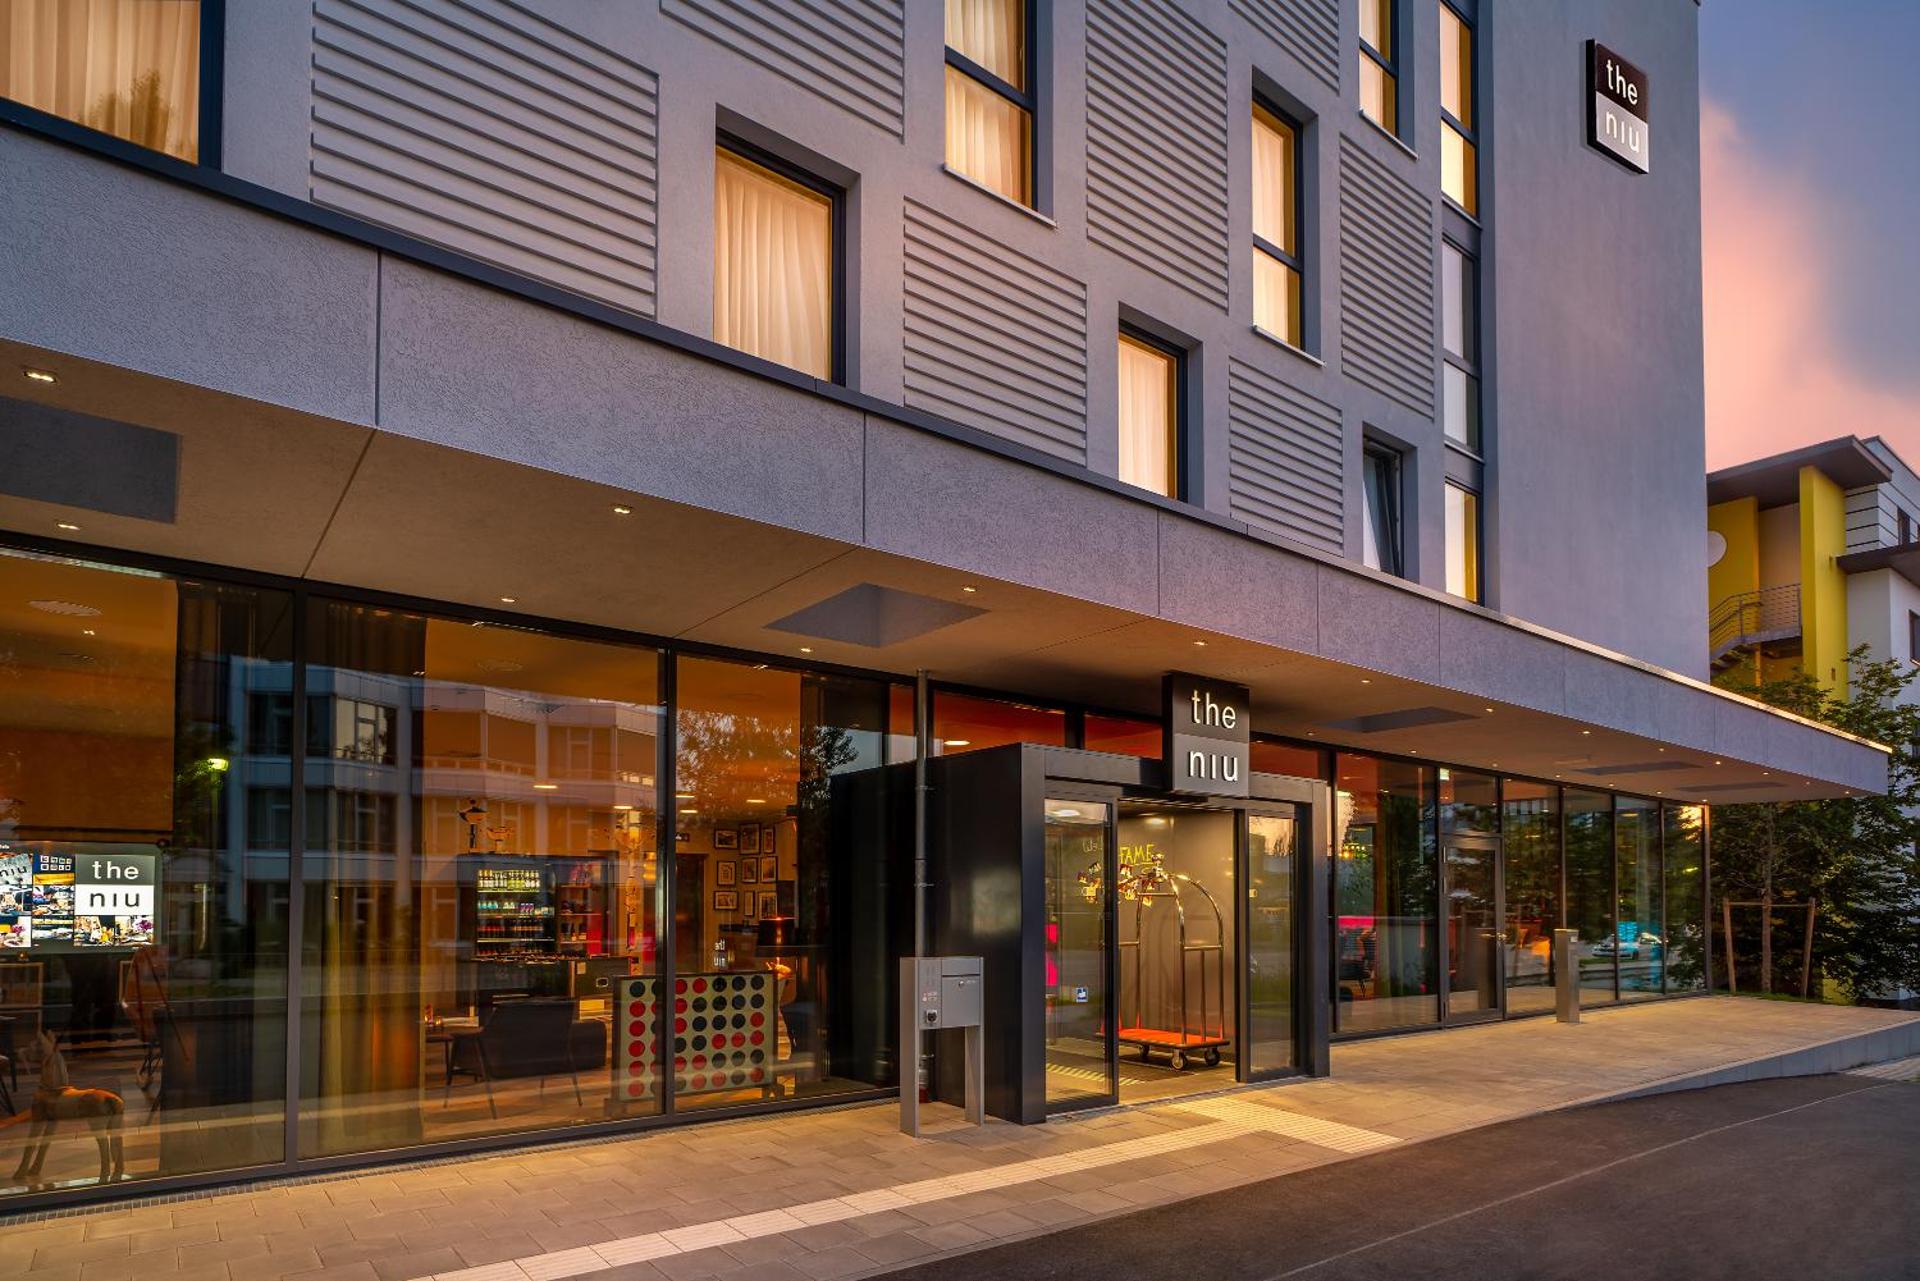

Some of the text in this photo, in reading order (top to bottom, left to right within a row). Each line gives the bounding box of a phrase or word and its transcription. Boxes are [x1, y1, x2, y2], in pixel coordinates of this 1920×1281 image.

[1606, 59, 1638, 105] the
[1606, 111, 1639, 153] niu
[1191, 690, 1236, 729] the
[1189, 750, 1238, 782] niu
[92, 860, 139, 880] the
[1119, 844, 1154, 865] FAME
[89, 892, 140, 908] niu
